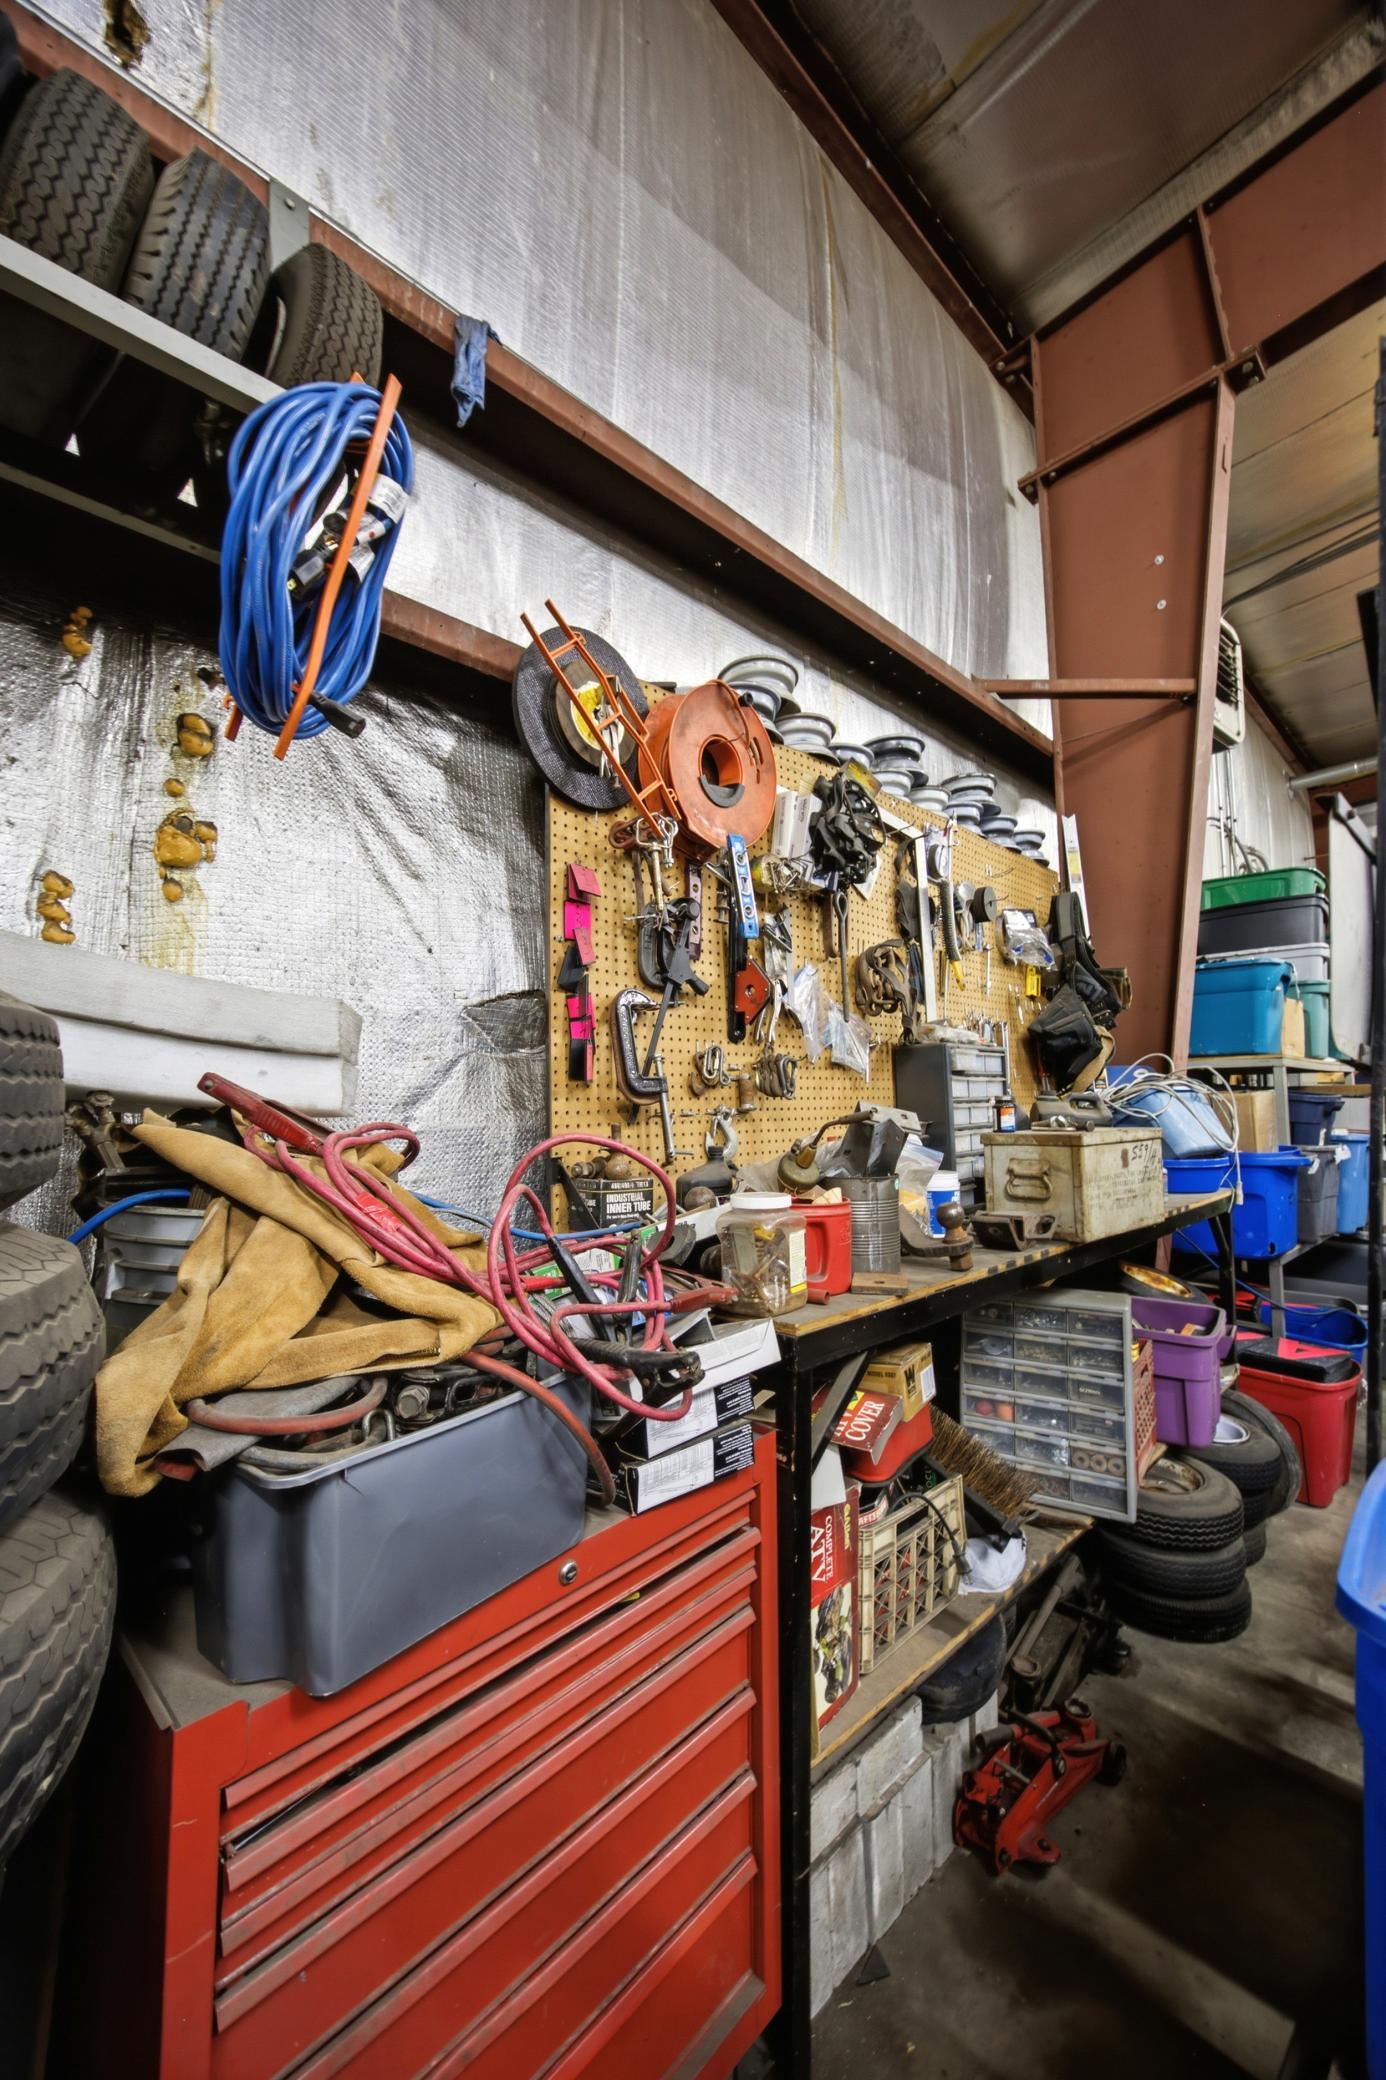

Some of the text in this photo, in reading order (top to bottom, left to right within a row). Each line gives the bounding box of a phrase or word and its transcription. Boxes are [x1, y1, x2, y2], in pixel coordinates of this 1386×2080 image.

[606, 1192, 645, 1203] INDUSTRIAL
[606, 1200, 652, 1214] INNER TUBE
[845, 1400, 885, 1441] COVER
[811, 1526, 826, 1581] ATV
[825, 1515, 834, 1580] COMPLETE
